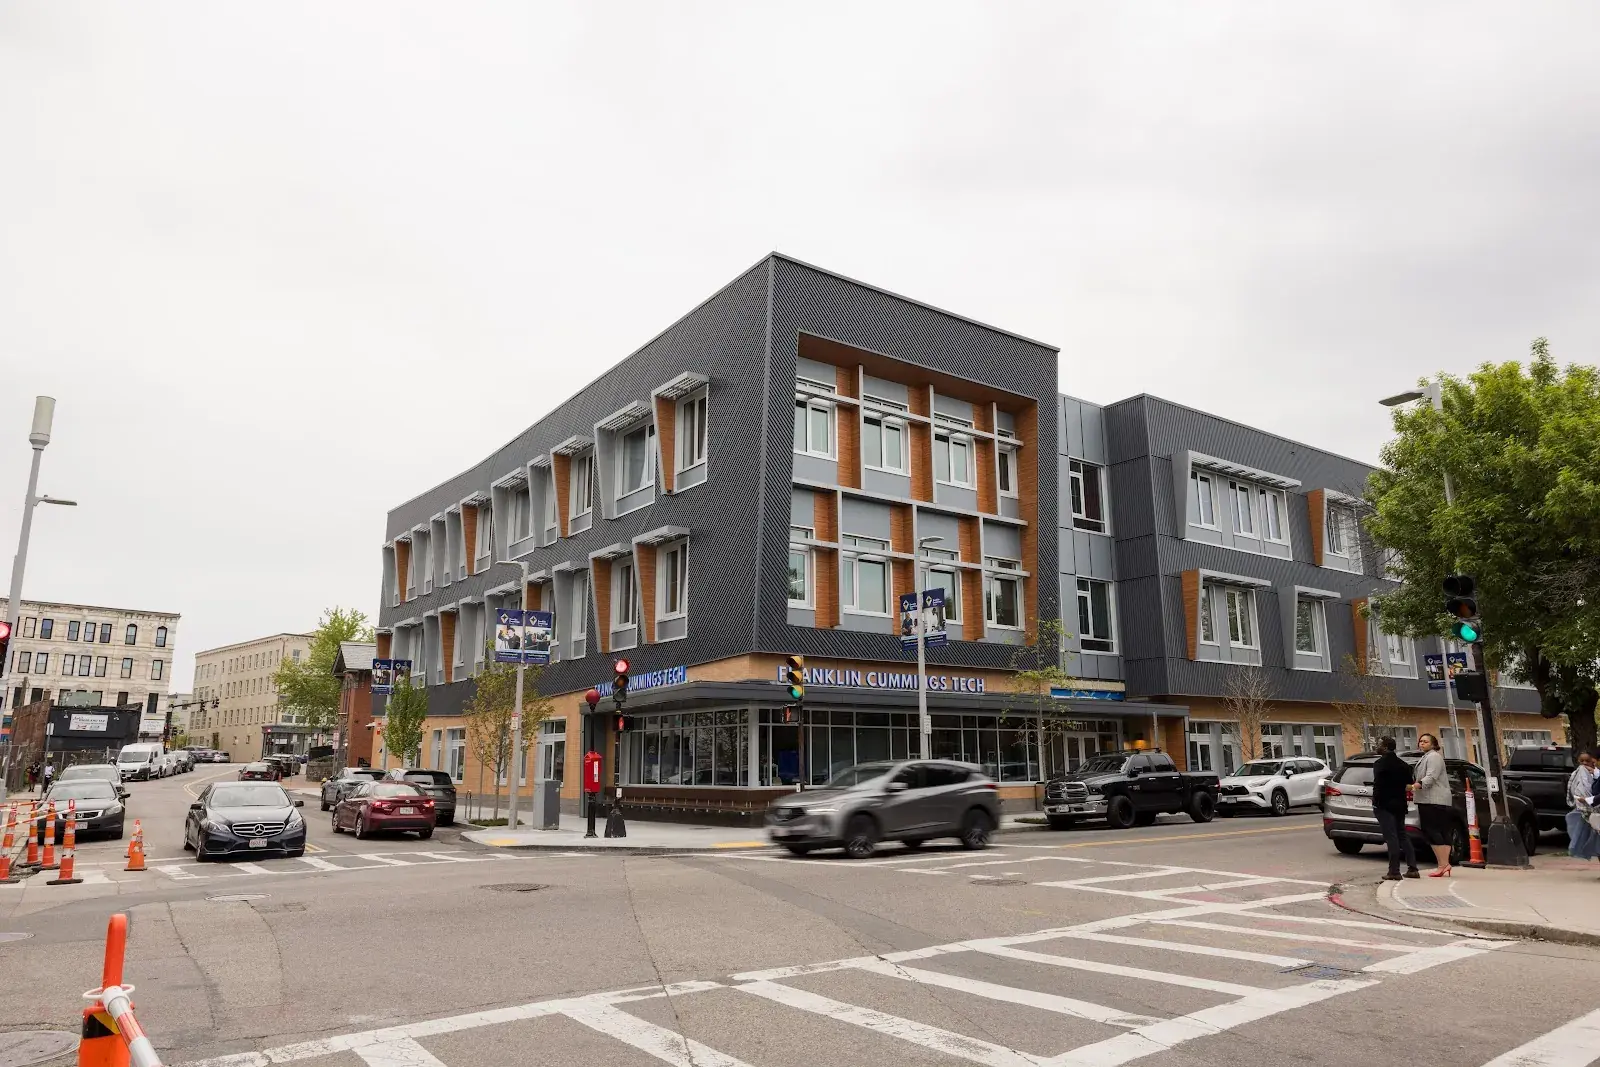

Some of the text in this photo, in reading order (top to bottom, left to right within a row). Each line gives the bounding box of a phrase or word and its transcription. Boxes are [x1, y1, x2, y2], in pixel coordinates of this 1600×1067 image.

[626, 670, 662, 692] UMMINGS
[664, 665, 686, 685] TECH
[866, 671, 947, 691] CUMMIGS
[952, 676, 985, 692] TECH
